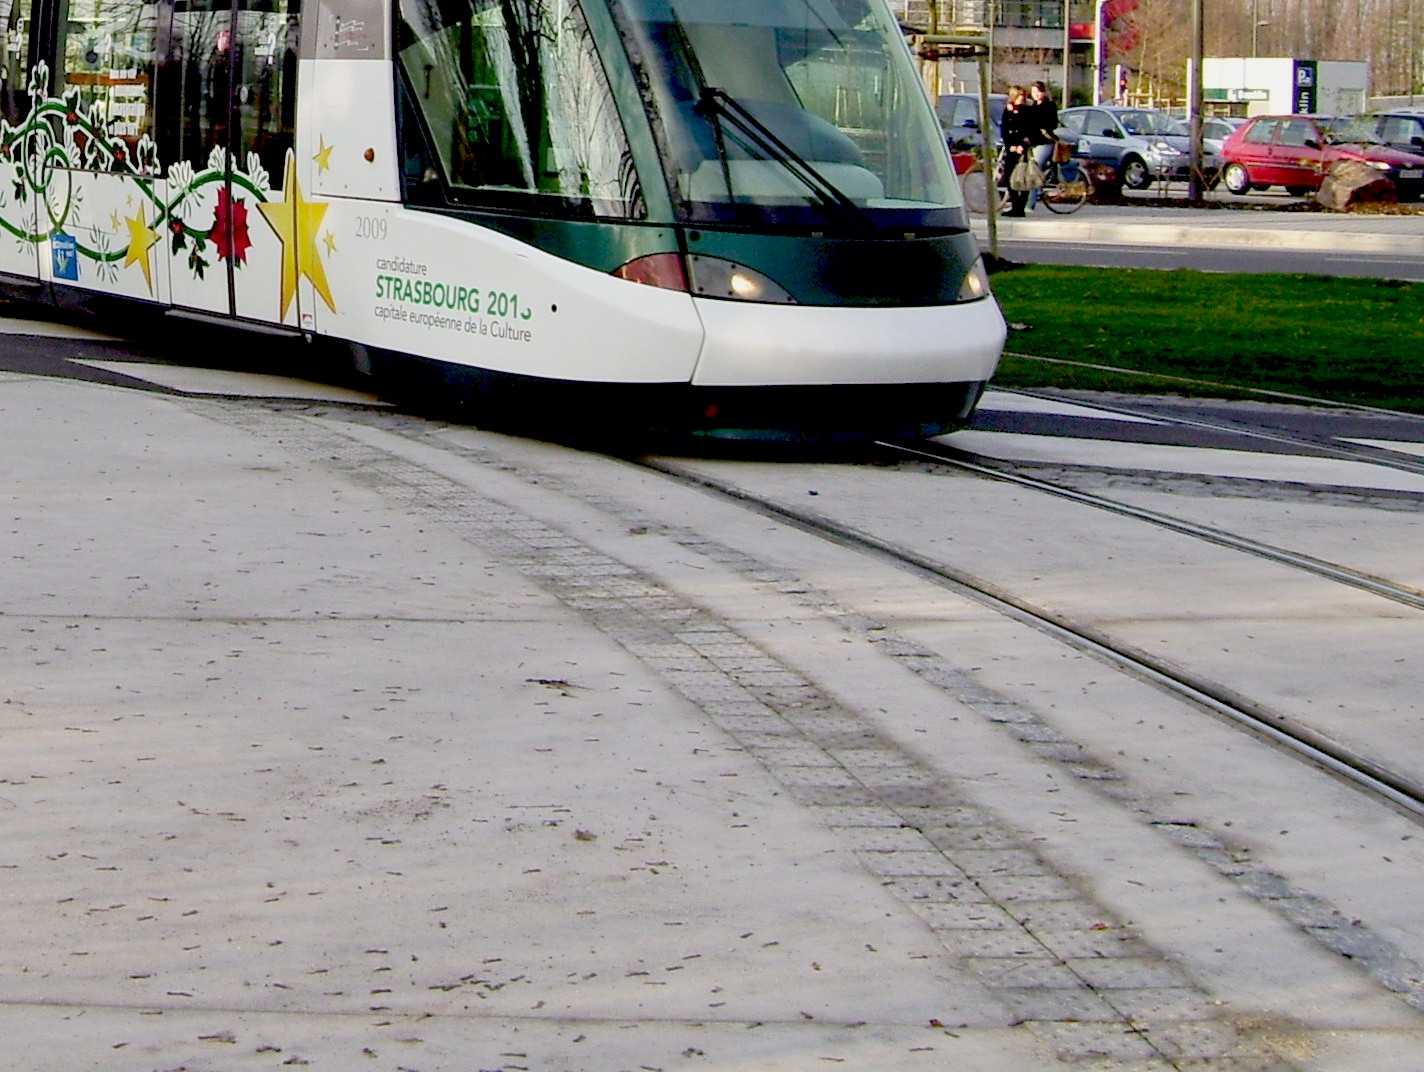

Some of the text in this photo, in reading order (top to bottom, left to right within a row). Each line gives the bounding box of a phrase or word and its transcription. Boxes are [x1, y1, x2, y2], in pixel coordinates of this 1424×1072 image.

[355, 215, 388, 240] 2009
[376, 256, 427, 276] candidature
[376, 275, 480, 313] STRASBOURG
[374, 304, 532, 343] capitale européenne de la Culture
